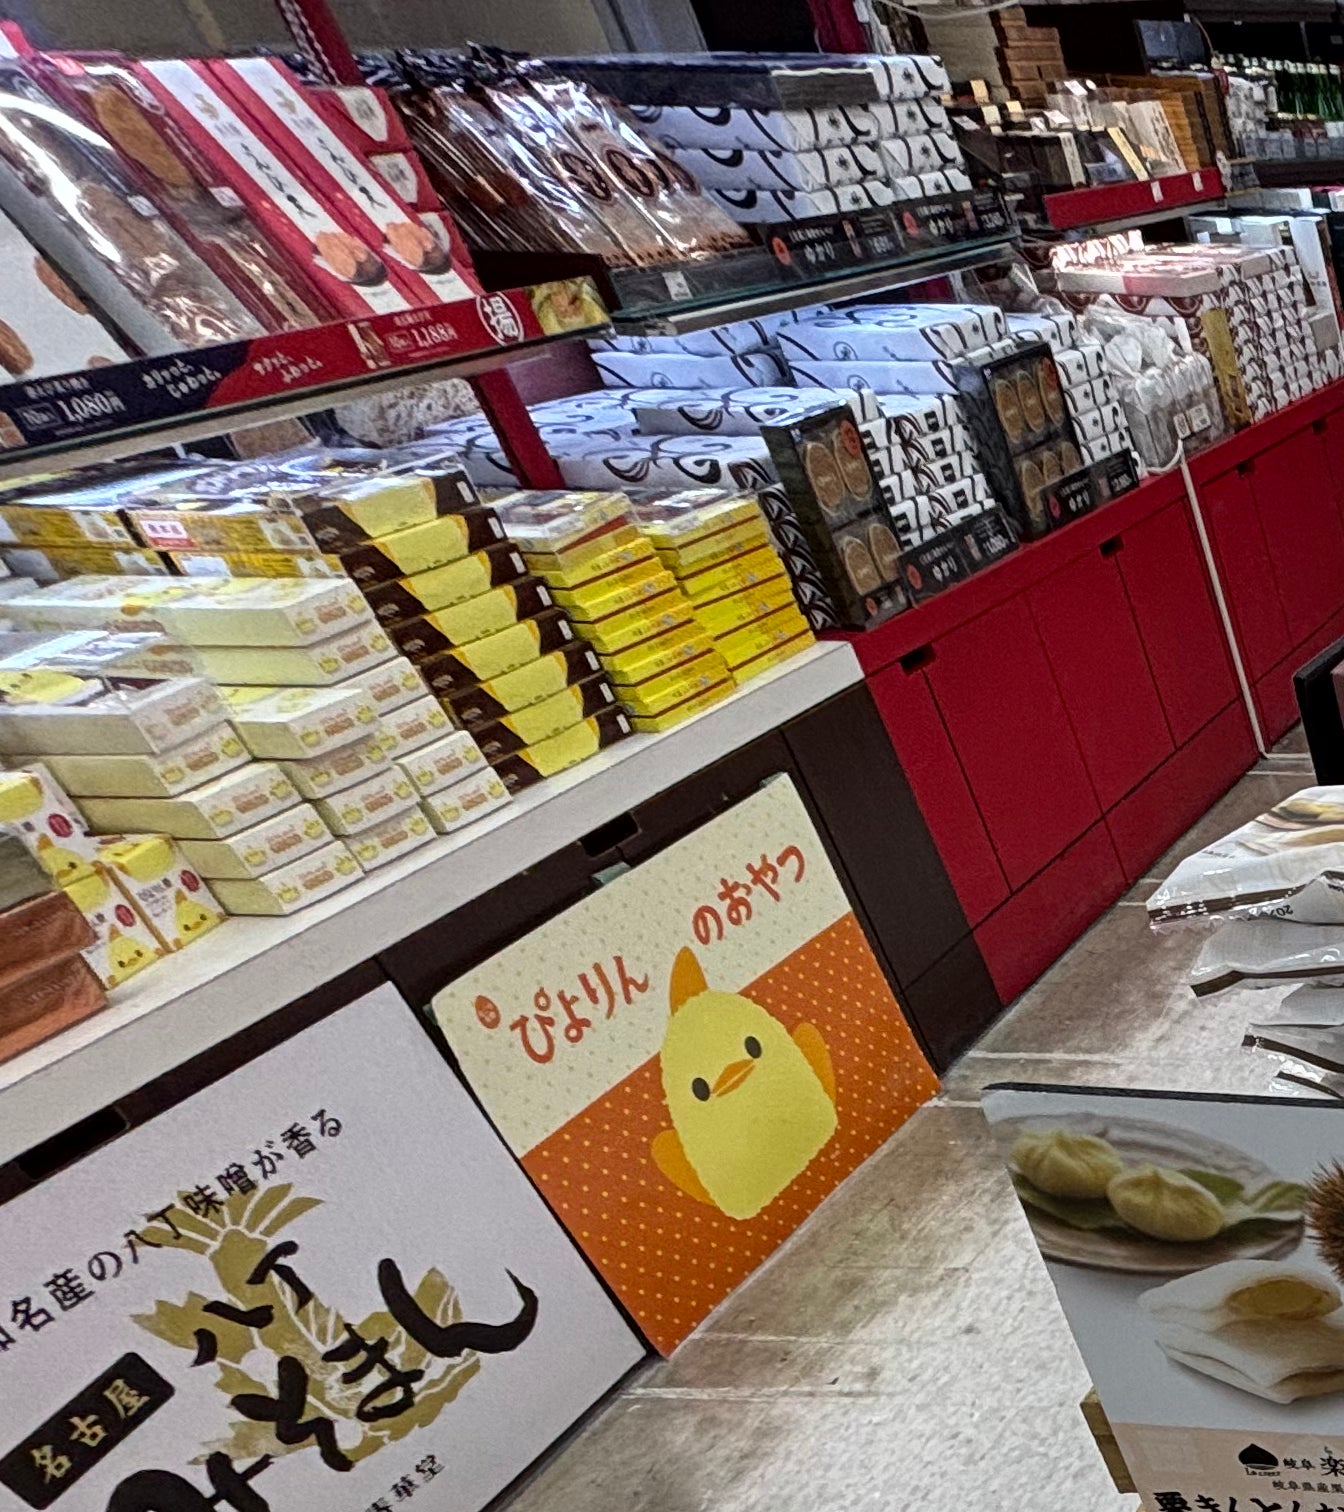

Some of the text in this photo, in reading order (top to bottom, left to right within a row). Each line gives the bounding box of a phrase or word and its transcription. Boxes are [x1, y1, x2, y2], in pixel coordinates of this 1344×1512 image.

[509, 844, 806, 1064] ぴよりん のおやつ
[0, 1108, 344, 1354] 名産の八丁味噌が香る
[29, 1378, 152, 1486] 名古屋
[1282, 1458, 1316, 1471] 岐阜
